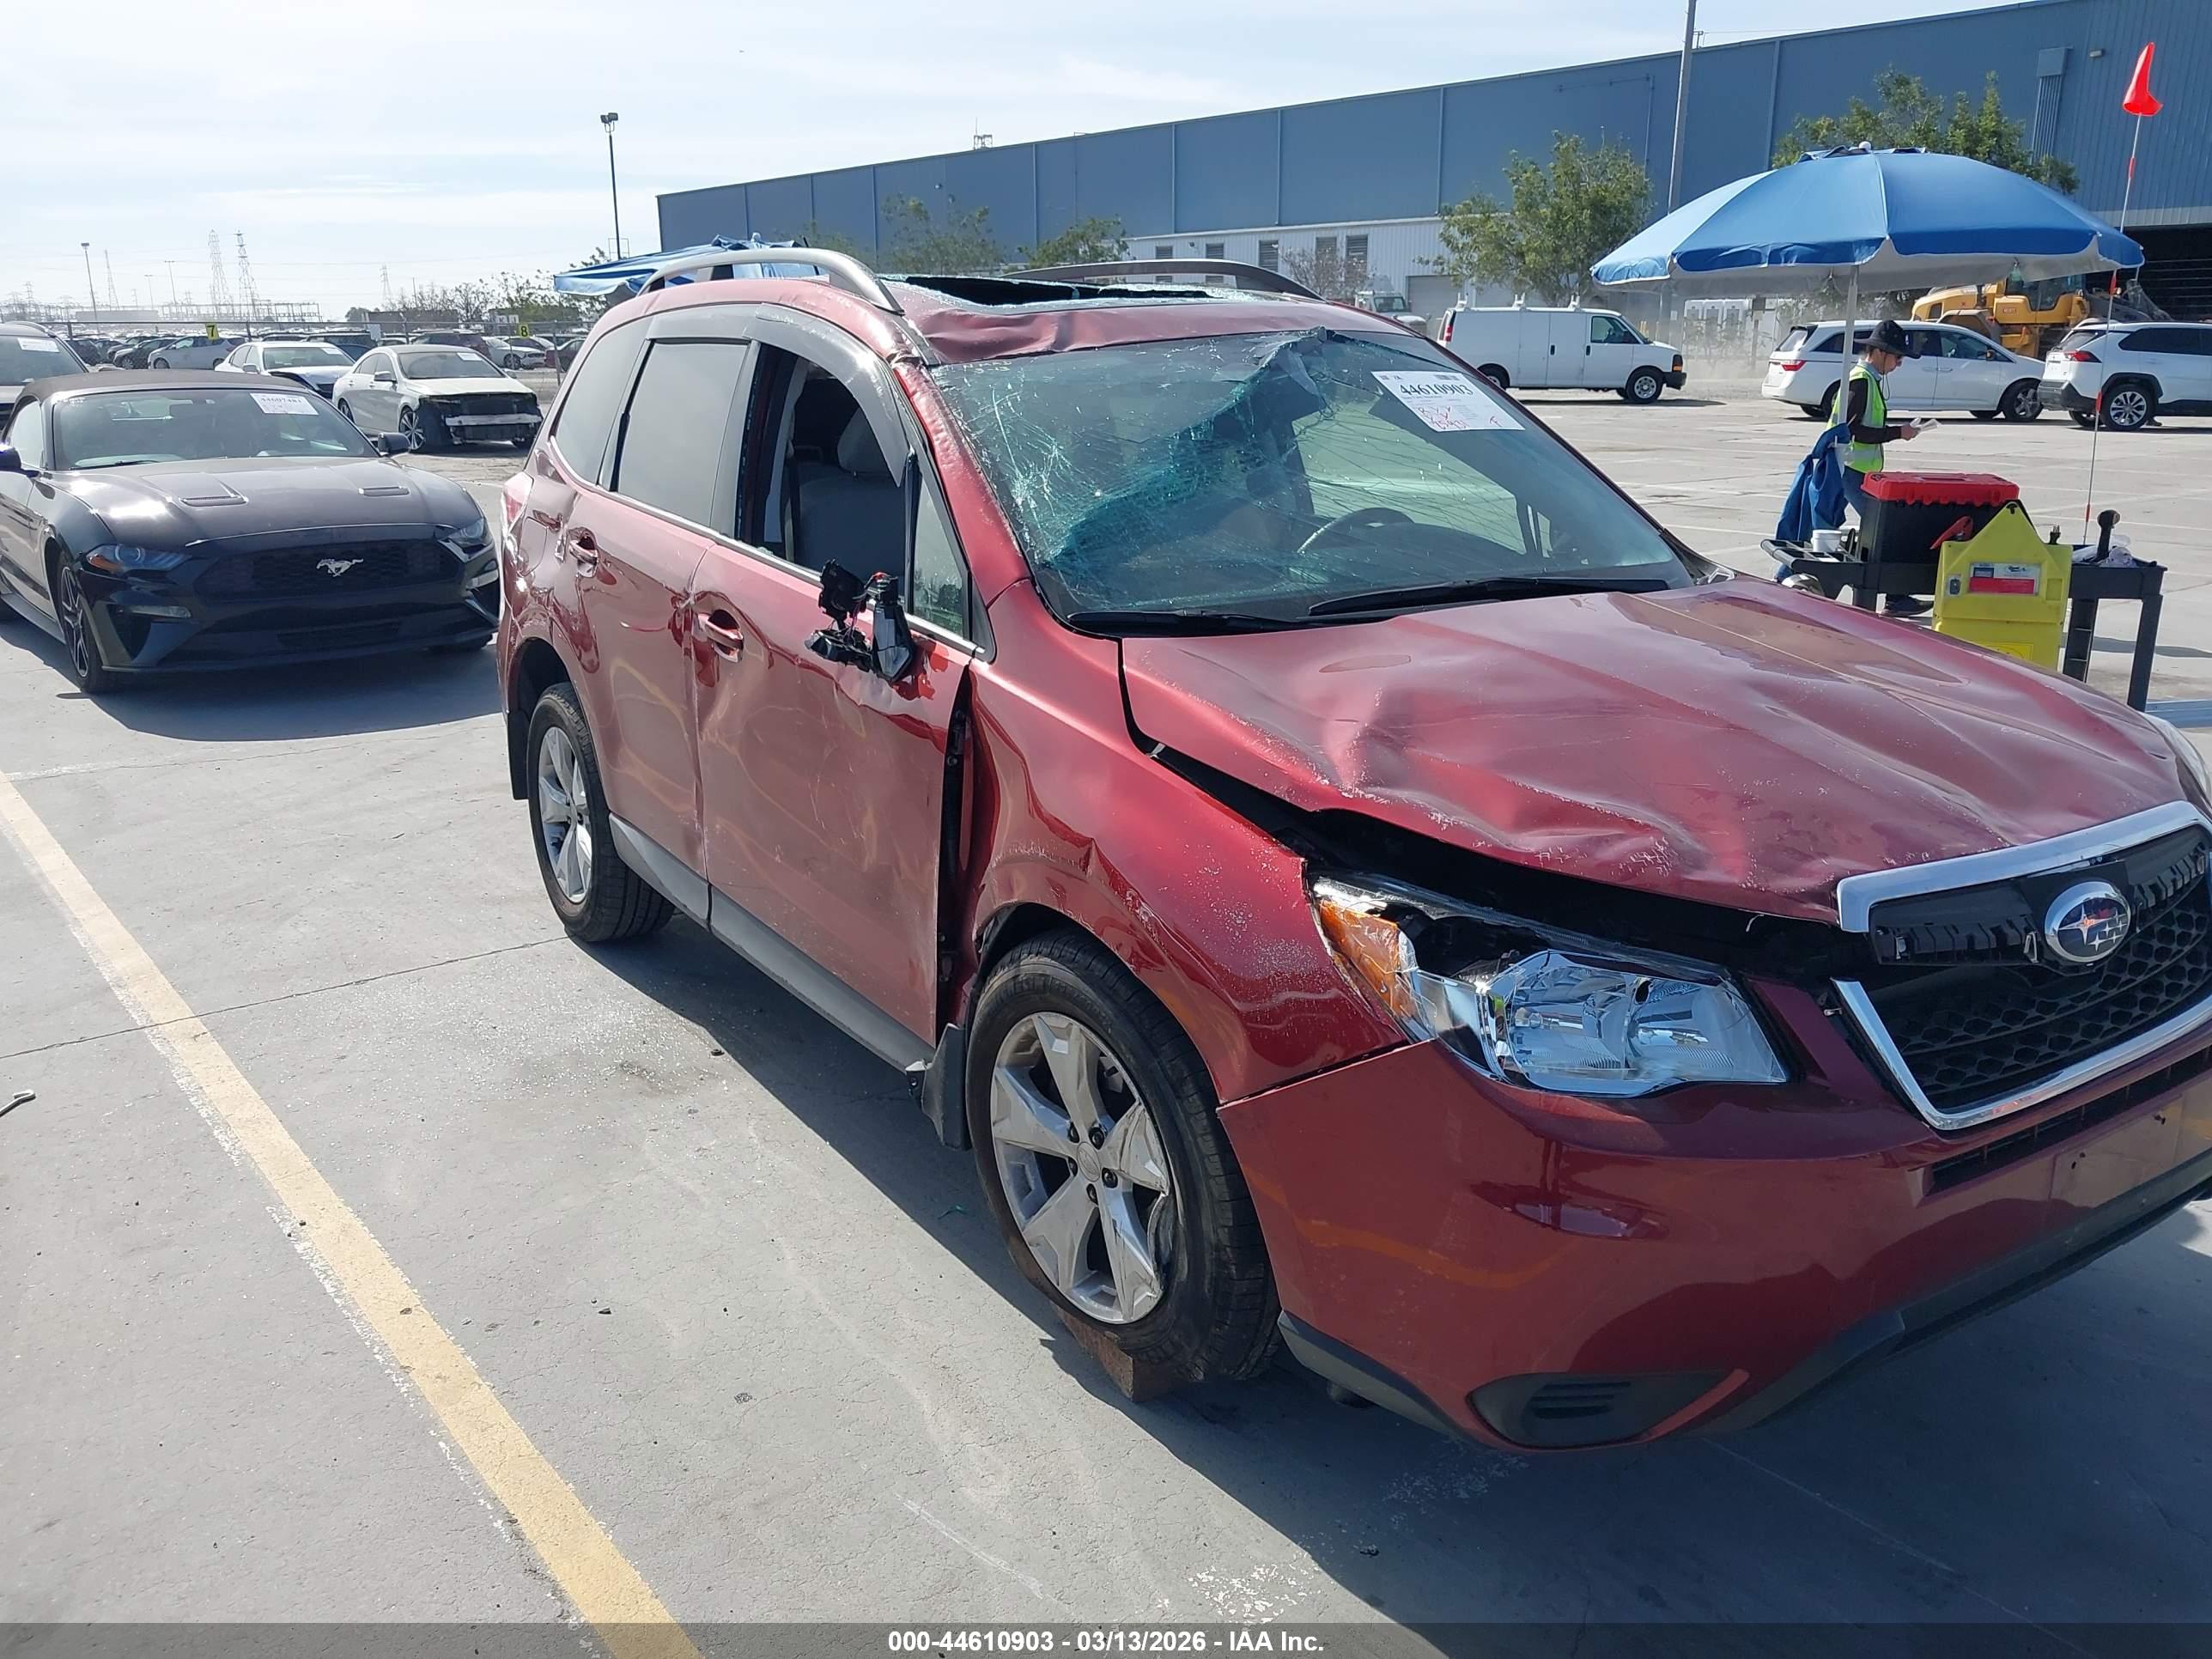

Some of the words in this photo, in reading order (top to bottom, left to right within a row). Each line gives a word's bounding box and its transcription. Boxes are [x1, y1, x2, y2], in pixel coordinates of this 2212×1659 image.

[207, 325, 216, 337] 7
[520, 325, 528, 337] 8
[1400, 383, 1474, 396] 44610903
